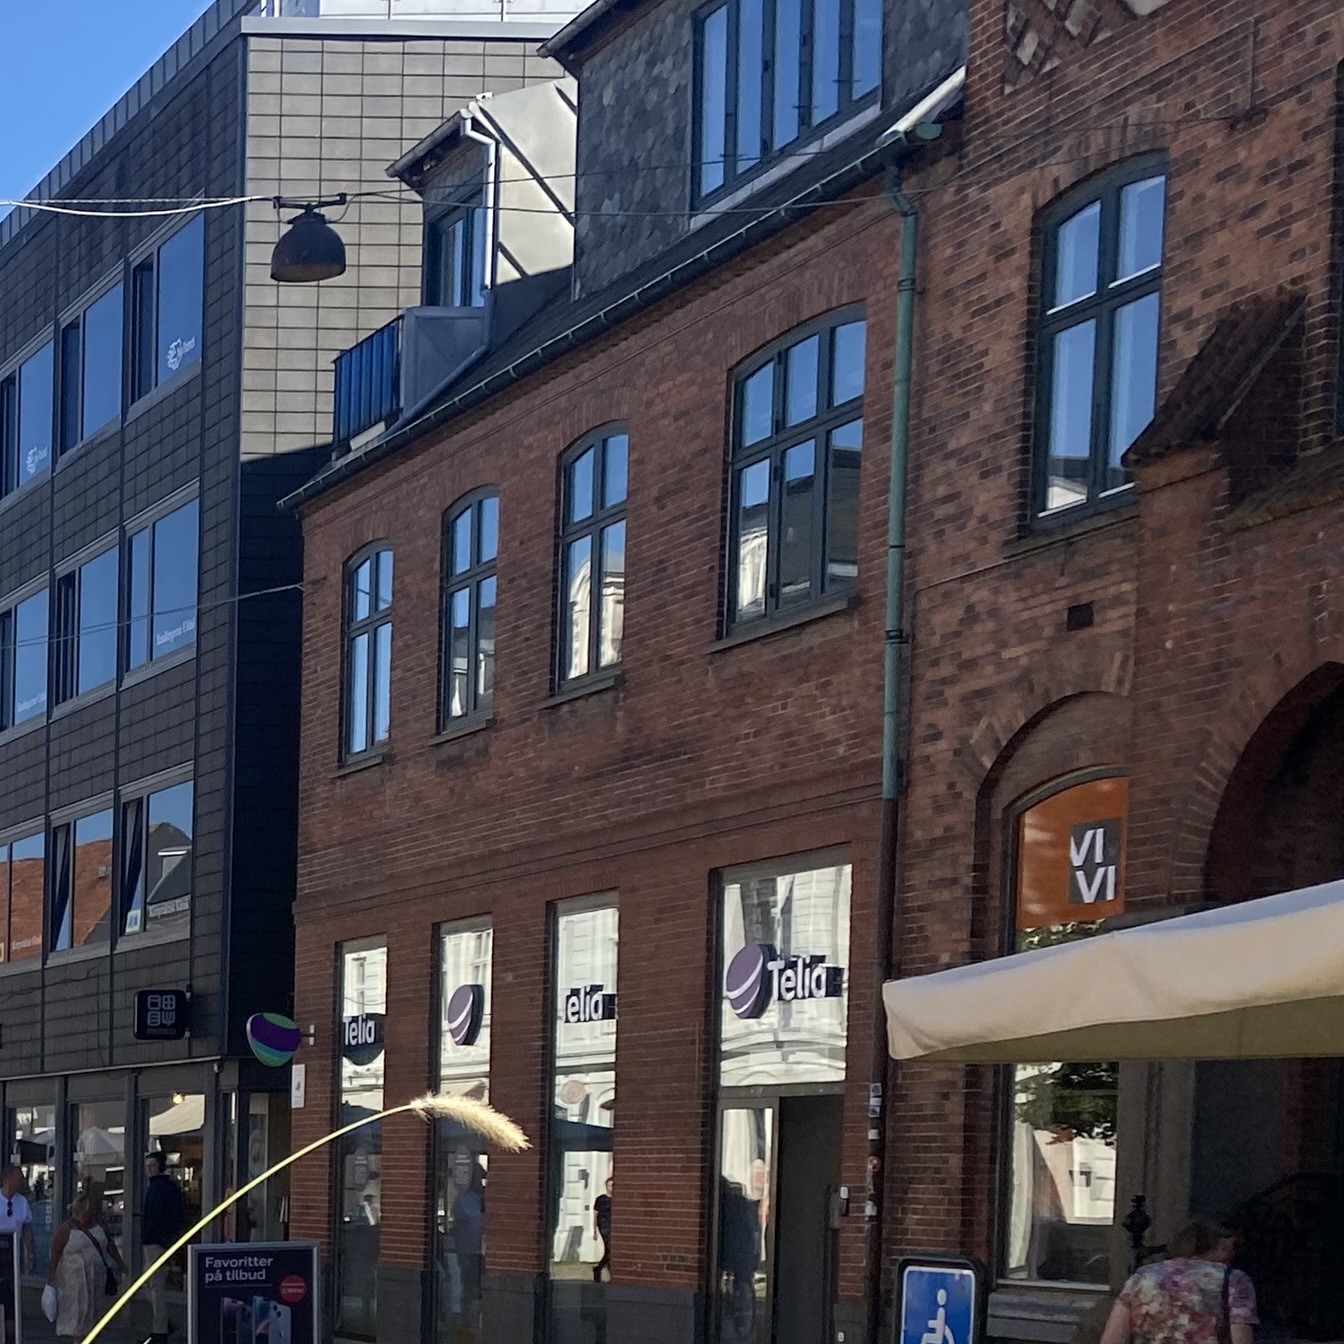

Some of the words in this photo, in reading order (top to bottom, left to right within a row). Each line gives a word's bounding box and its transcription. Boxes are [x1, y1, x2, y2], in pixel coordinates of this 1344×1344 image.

[1069, 827, 1104, 867] VI
[1075, 865, 1116, 904] VI
[767, 955, 827, 1001] Telia
[342, 1013, 375, 1046] Telia
[205, 1255, 274, 1268] Favoritter
[205, 1269, 223, 1283] på
[226, 1268, 266, 1282] tilbud
